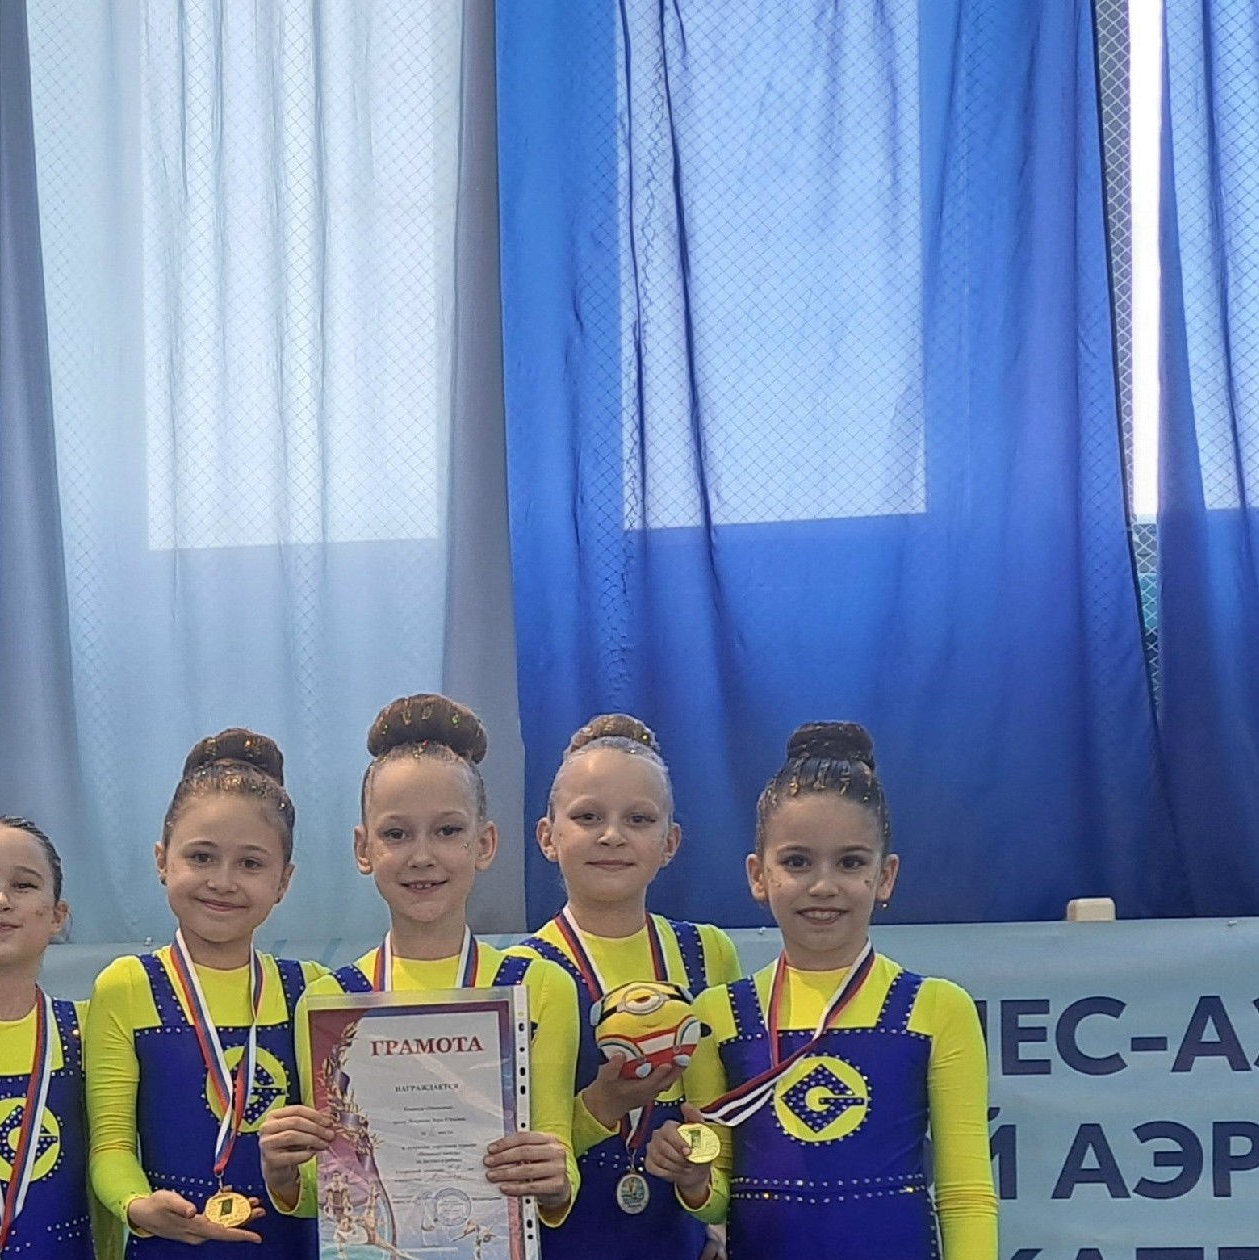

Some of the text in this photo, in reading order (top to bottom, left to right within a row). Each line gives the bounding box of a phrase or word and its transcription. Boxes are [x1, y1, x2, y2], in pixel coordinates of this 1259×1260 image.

[371, 1036, 484, 1057] ГРАМОТА
[977, 995, 1259, 1076] ЕС-А
[780, 1063, 865, 1133] G
